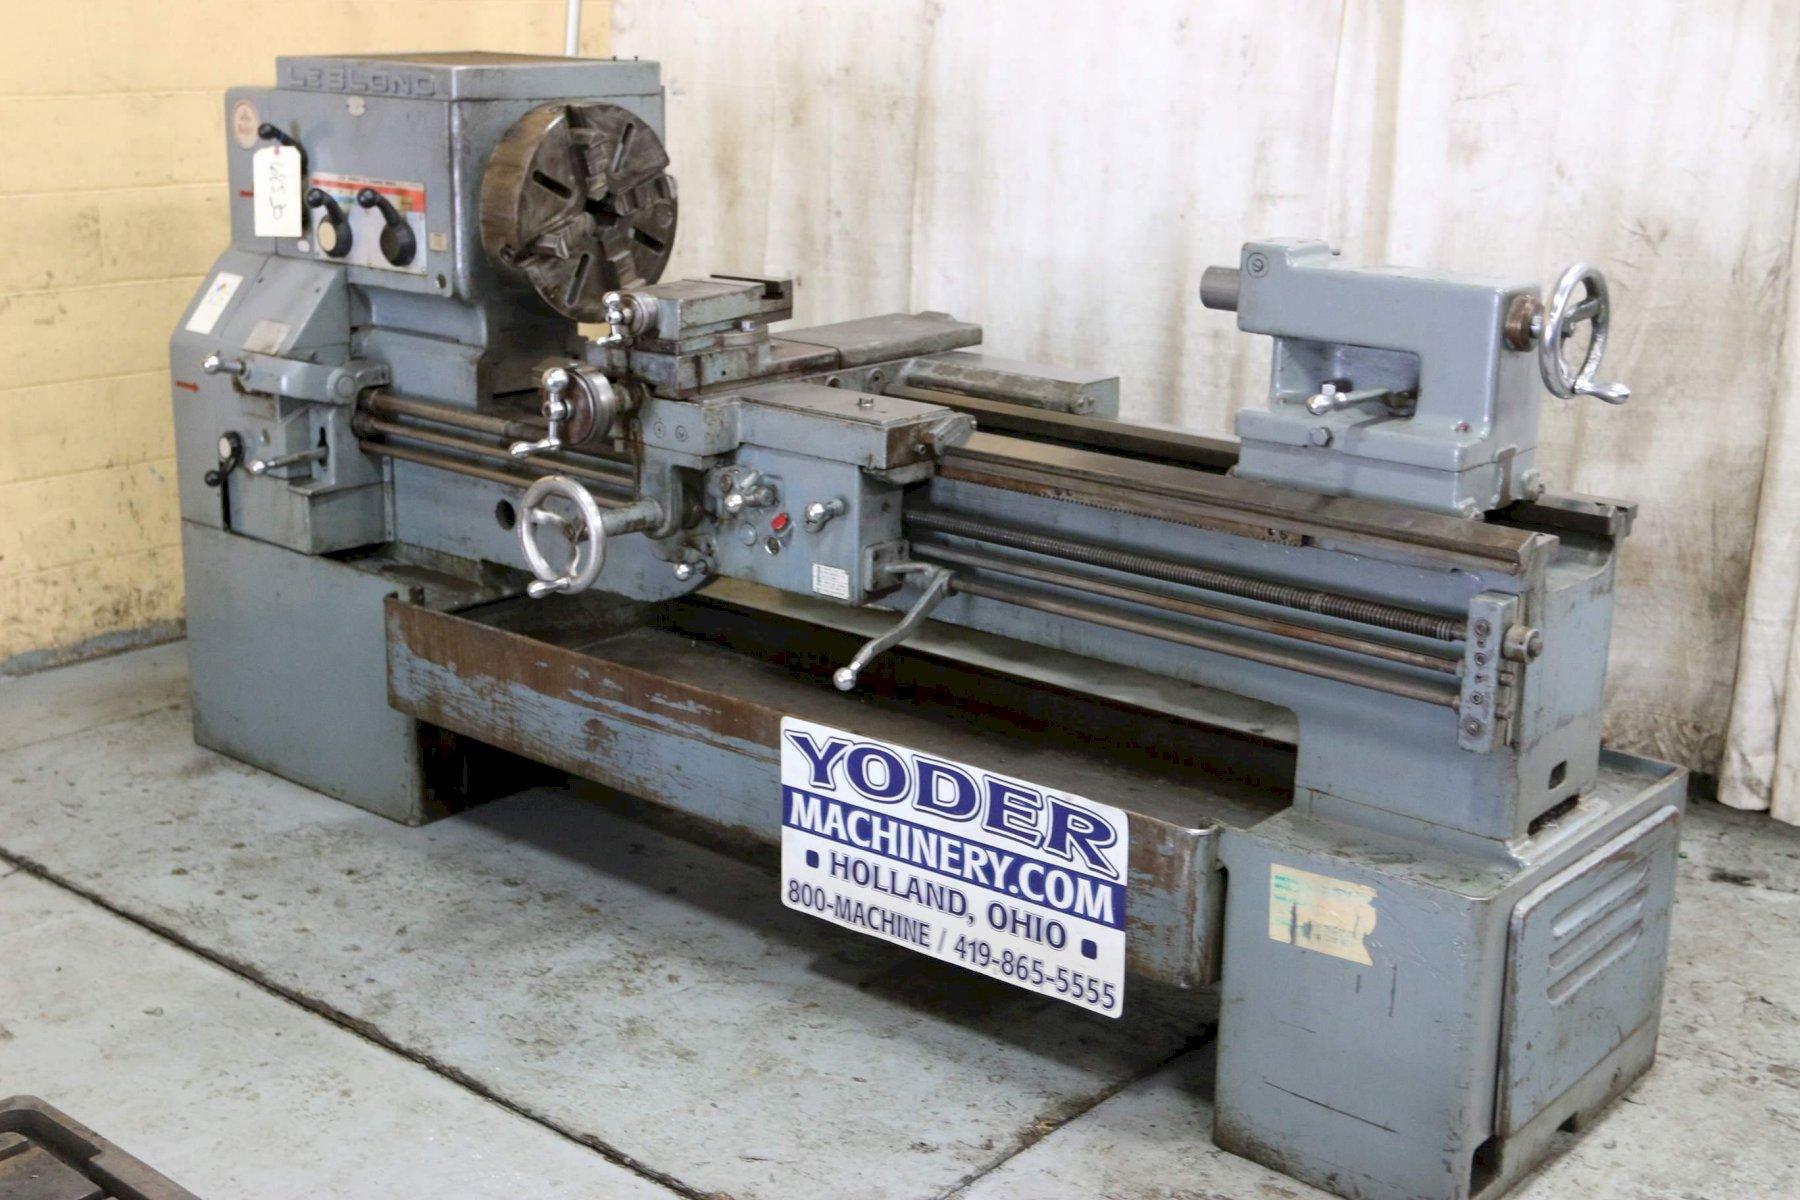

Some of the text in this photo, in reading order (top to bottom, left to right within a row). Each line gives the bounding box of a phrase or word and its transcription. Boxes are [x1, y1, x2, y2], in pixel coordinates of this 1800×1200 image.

[784, 729, 1119, 880] YODER
[790, 792, 1114, 924] MACHINERY.COM
[788, 880, 931, 947] 800-MACHINE
[953, 935, 1116, 1010] 419-865-5555
[830, 851, 1067, 950] HOLLAND, OHIO
